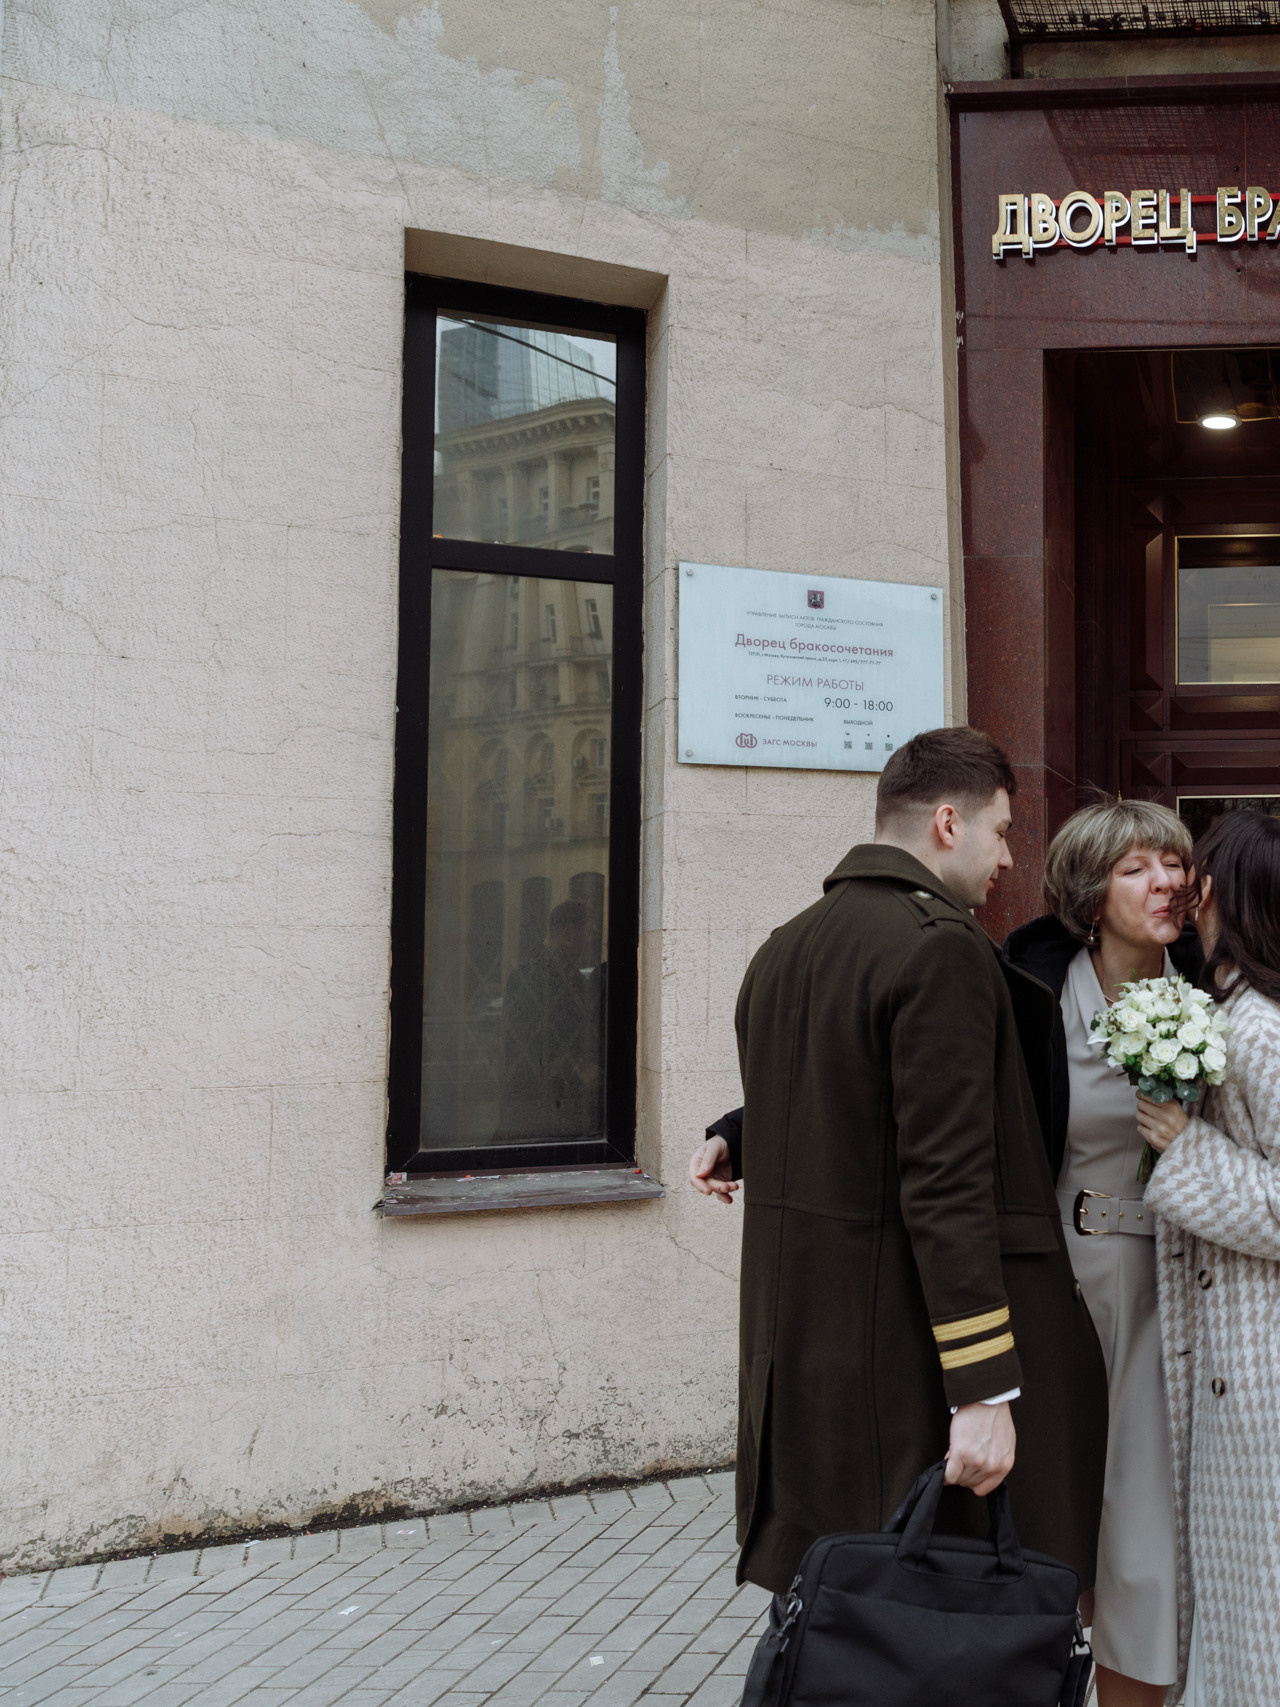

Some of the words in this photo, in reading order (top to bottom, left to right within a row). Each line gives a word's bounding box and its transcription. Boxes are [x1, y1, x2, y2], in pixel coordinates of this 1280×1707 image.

[992, 188, 1197, 260] ДВОРЕЦ
[734, 633, 787, 651] Дворец
[789, 638, 894, 658] бракосочетания
[766, 674, 813, 688] РЕЖИМ
[817, 678, 864, 691] РАБОТЫ
[824, 697, 851, 709] 9:00
[863, 699, 894, 712] 18:00
[735, 712, 771, 720] ВОСКРЕСЕНЬЕ
[762, 738, 781, 746] ЗАГС
[783, 739, 818, 748] МОСКВЫ
